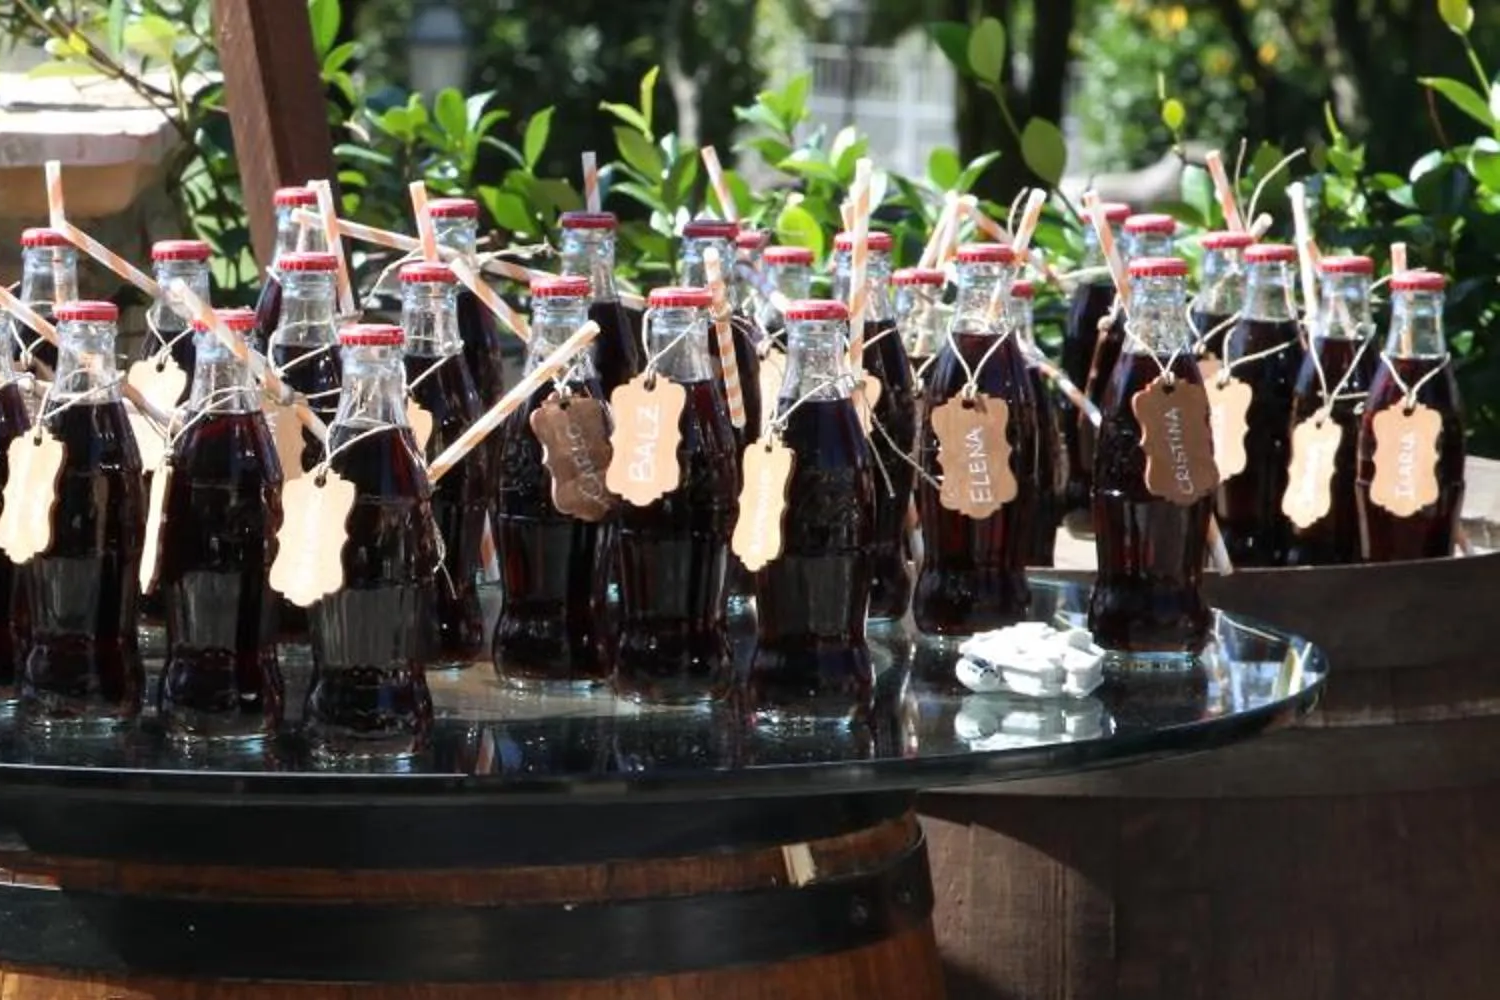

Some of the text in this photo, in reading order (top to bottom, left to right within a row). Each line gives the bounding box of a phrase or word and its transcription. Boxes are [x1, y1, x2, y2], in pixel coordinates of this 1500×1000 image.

[631, 404, 660, 482] BALZ
[965, 425, 993, 504] ELENA
[1163, 407, 1194, 494] CRISTINA
